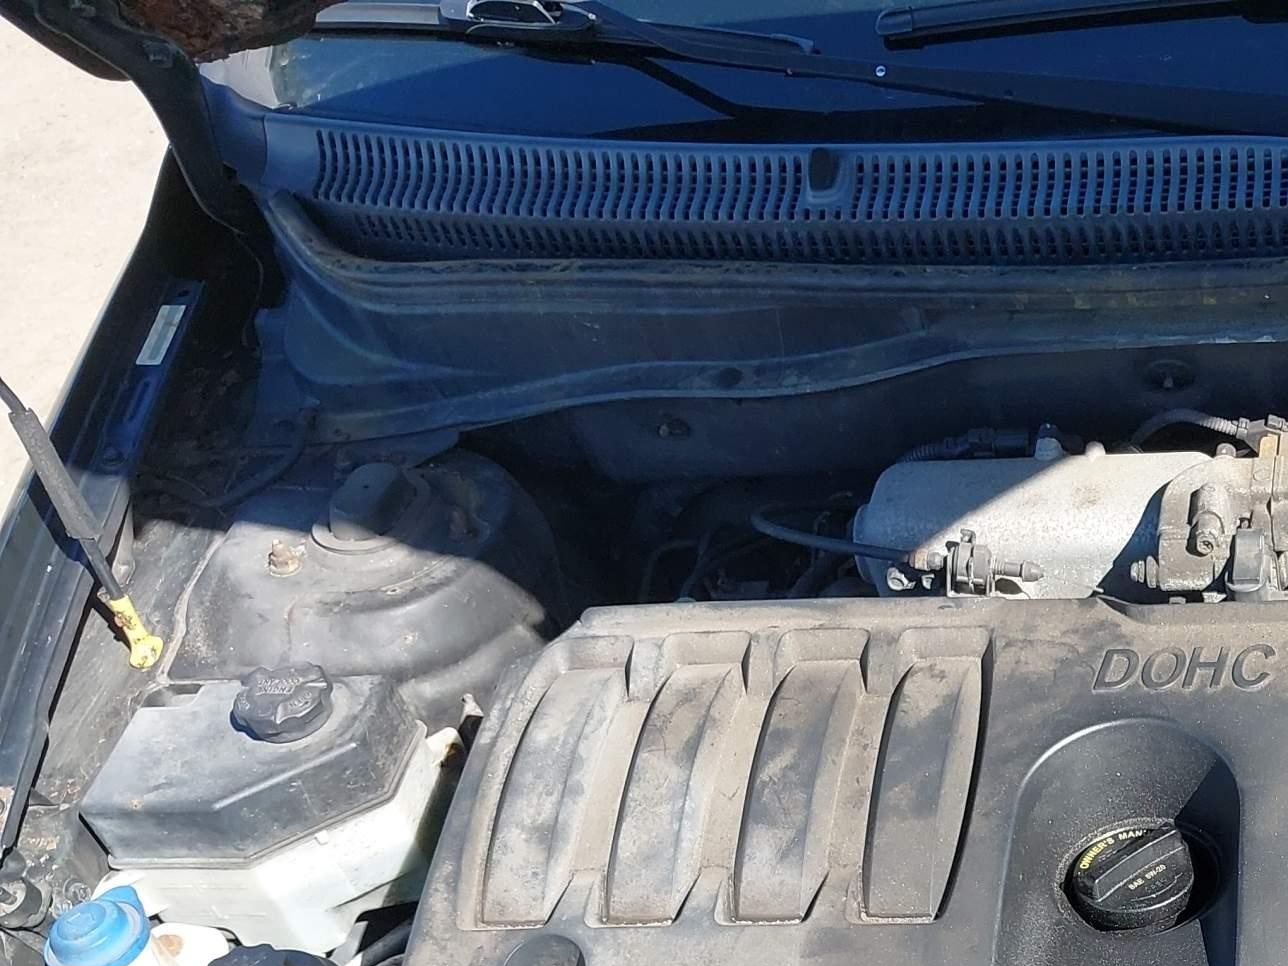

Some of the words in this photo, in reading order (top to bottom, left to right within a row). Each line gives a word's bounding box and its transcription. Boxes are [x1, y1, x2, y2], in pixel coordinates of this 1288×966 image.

[1091, 643, 1278, 692] DOHC
[1080, 837, 1115, 869] OWNER'S
[1118, 829, 1147, 840] MAN
